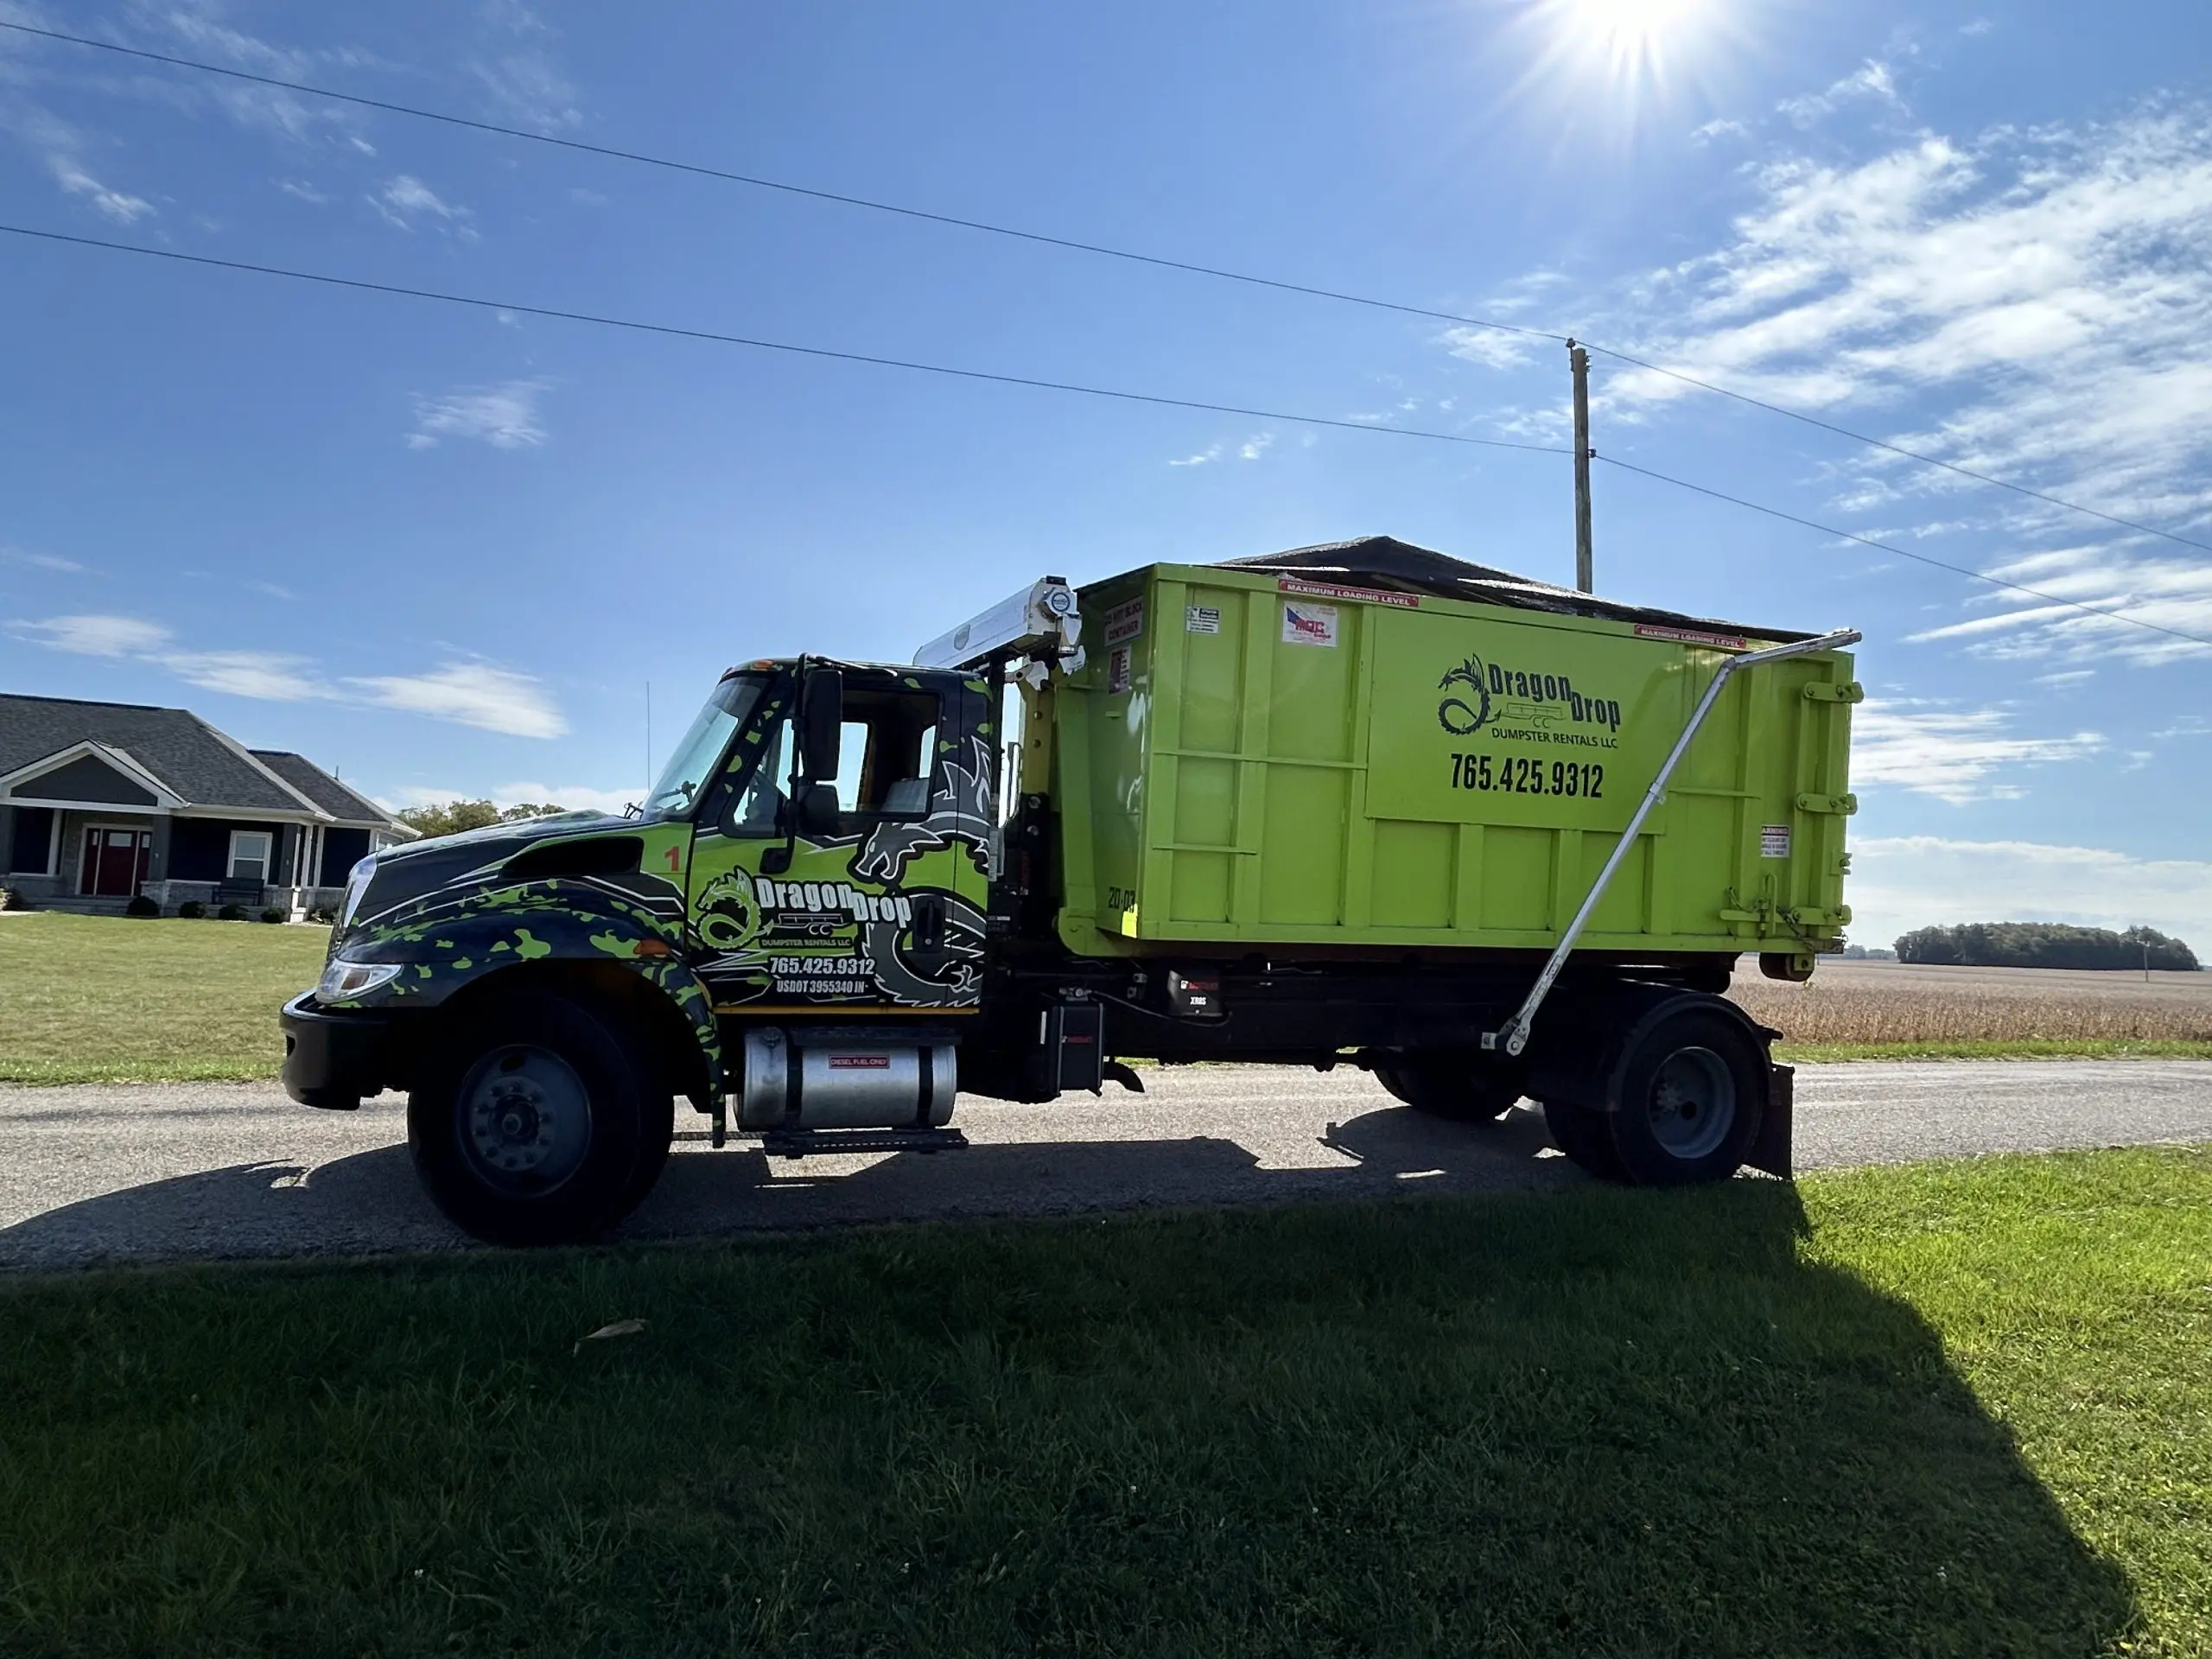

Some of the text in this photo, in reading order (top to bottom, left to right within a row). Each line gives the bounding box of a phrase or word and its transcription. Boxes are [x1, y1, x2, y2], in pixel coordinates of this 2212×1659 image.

[1287, 584, 1410, 605] MAXIMUM LOADING LEVEL
[1641, 628, 1739, 647] MAXIMUM LOADING LEVEL
[1488, 663, 1621, 733] Dragon Drop
[1491, 728, 1618, 749] DUMPSTER RENTALS LLC
[1451, 753, 1604, 798] 765.425.9312
[664, 845, 681, 872] 1
[755, 878, 912, 929] Dragon Drop
[770, 957, 876, 975] 765.425.9312
[777, 980, 809, 993] USDOT
[809, 980, 853, 993] 3955340
